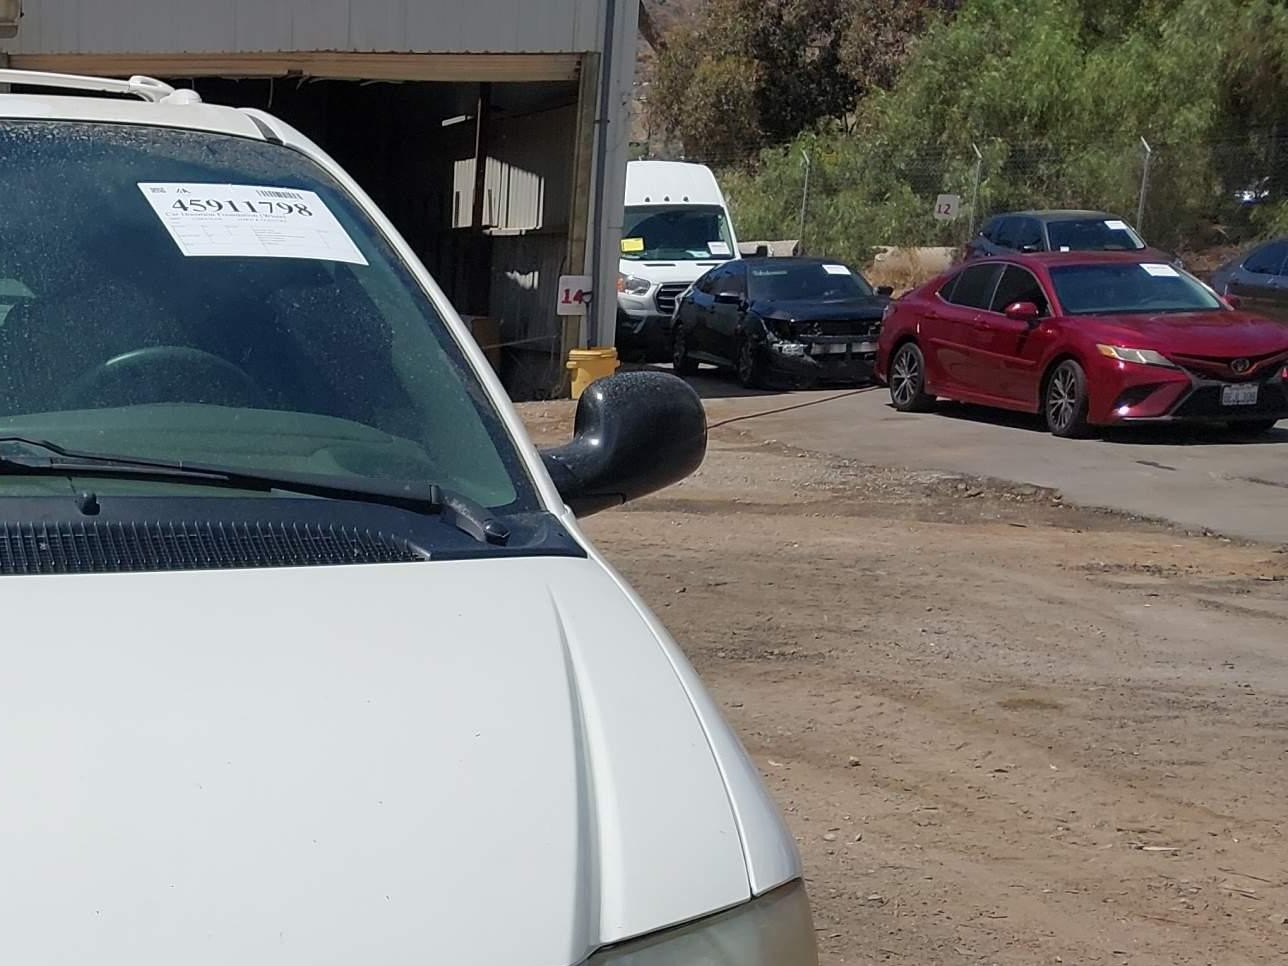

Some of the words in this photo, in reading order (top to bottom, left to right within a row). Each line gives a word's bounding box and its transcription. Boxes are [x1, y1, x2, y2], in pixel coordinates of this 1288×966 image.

[172, 198, 312, 217] 45911798
[937, 203, 951, 215] 12
[561, 288, 584, 304] 14
